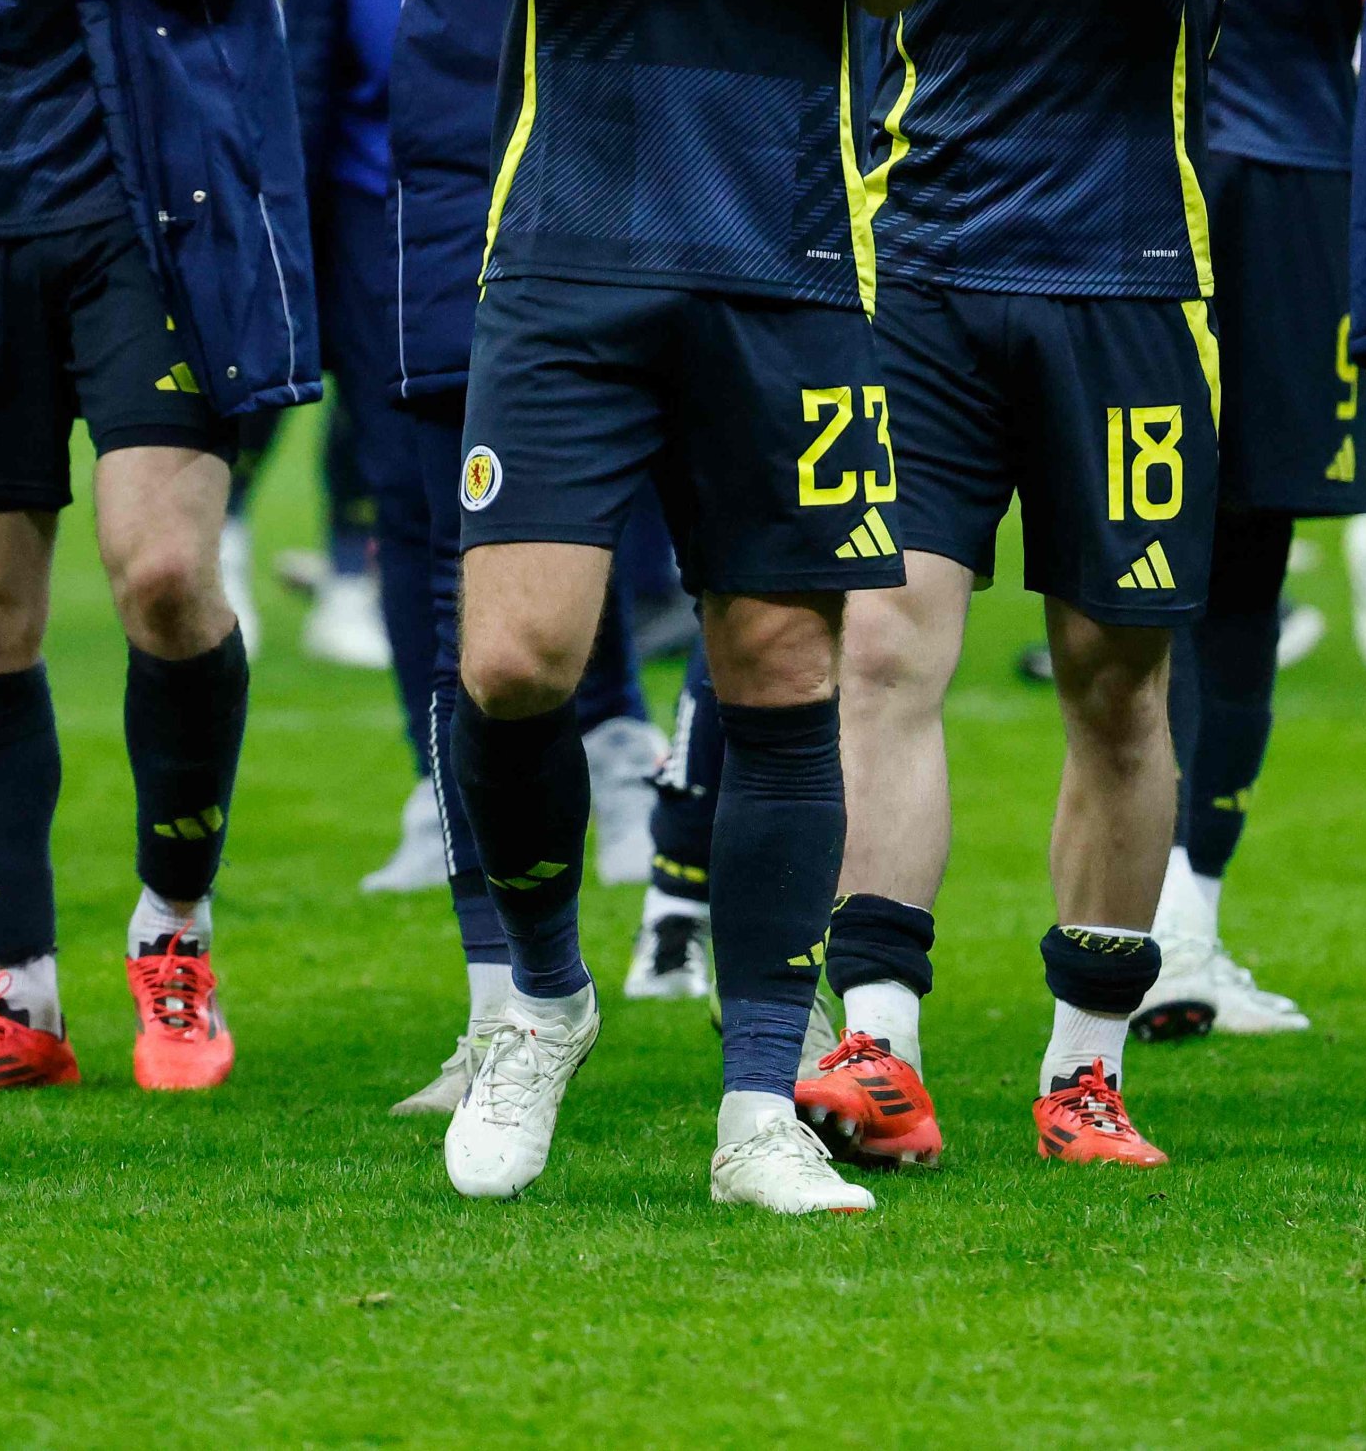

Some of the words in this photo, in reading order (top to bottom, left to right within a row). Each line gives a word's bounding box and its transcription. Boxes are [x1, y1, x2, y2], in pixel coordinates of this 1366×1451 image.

[806, 249, 842, 261] AEROREADY
[1142, 249, 1179, 259] AEROREADY
[798, 386, 897, 510] 23
[1107, 406, 1183, 521] 18
